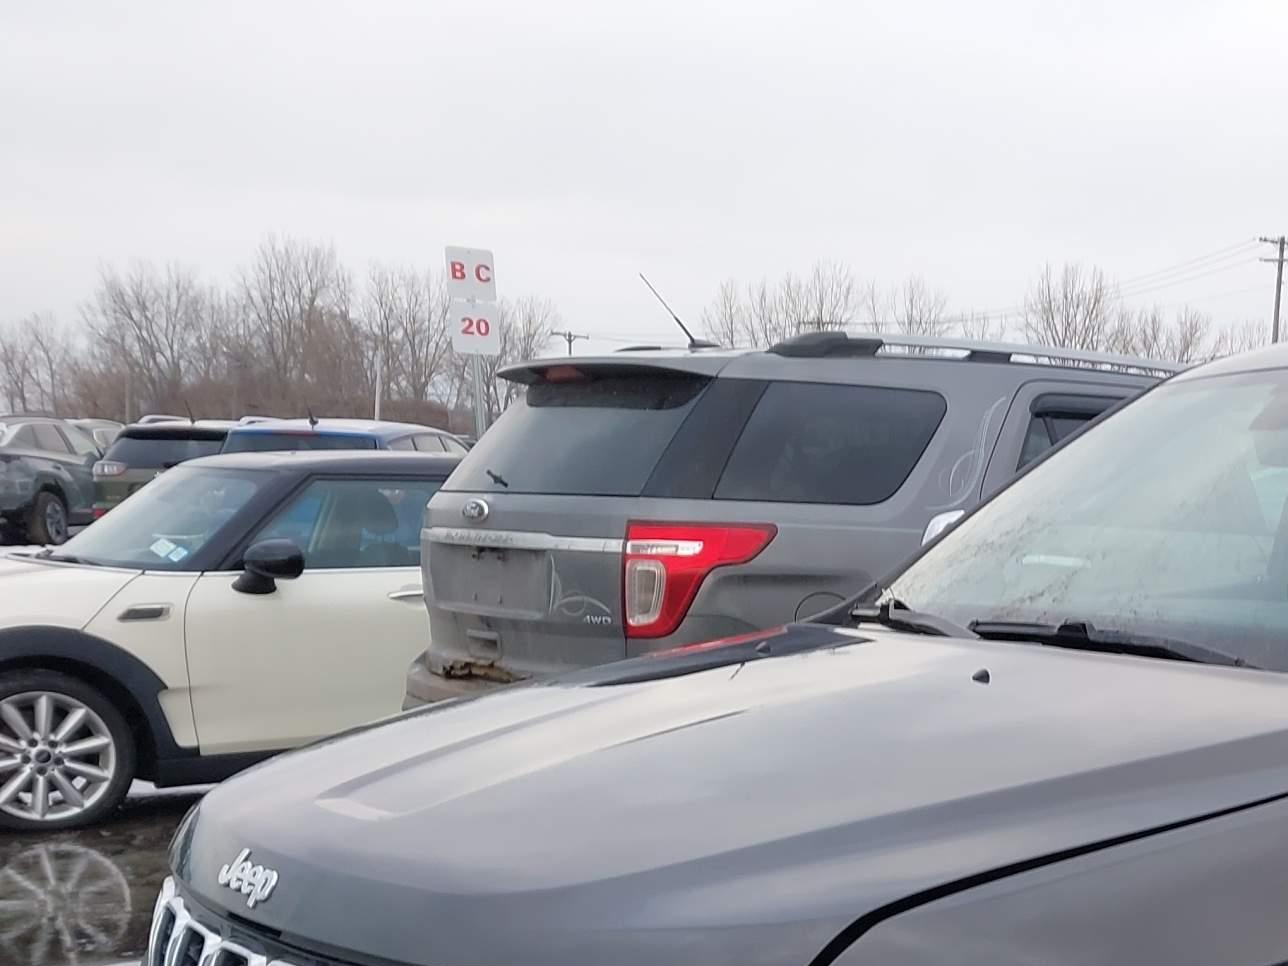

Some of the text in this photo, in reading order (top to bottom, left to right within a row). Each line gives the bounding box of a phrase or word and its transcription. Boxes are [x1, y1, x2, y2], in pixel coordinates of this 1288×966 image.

[450, 260, 491, 282] B C
[460, 317, 490, 336] 20
[218, 847, 279, 909] Jeep
